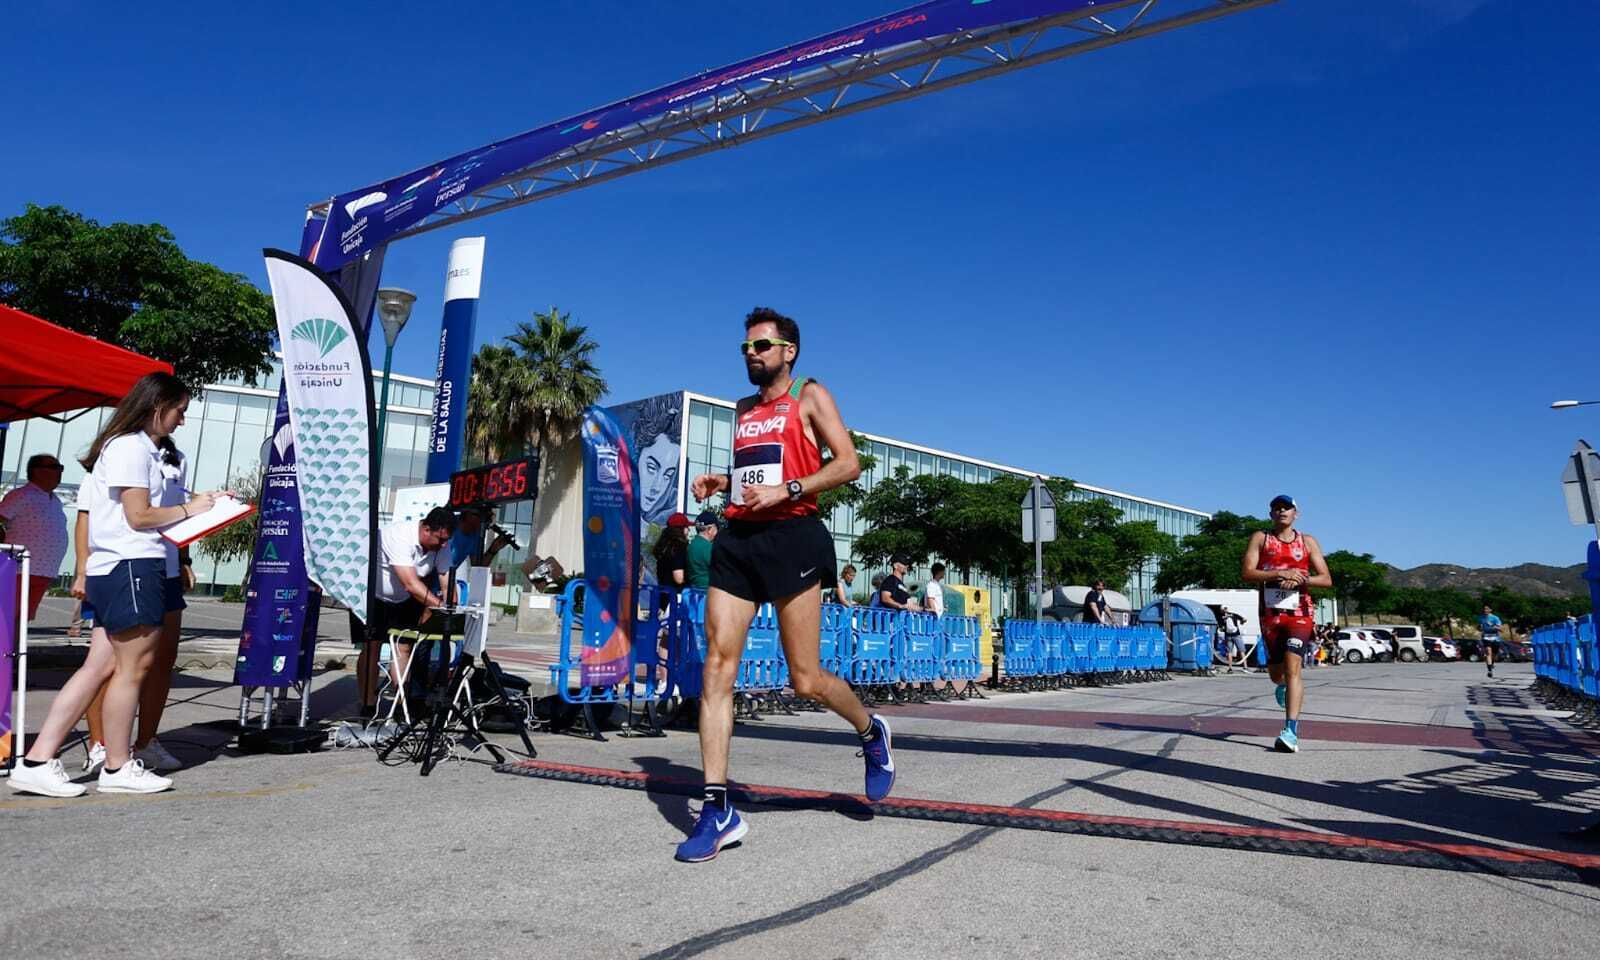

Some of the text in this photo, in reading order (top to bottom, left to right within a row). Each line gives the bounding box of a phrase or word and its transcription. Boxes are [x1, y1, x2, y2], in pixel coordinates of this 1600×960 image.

[436, 380, 453, 453] DE LA SALUD
[736, 415, 786, 439] KENYA
[268, 463, 297, 473] Fundació
[741, 469, 765, 485] 486
